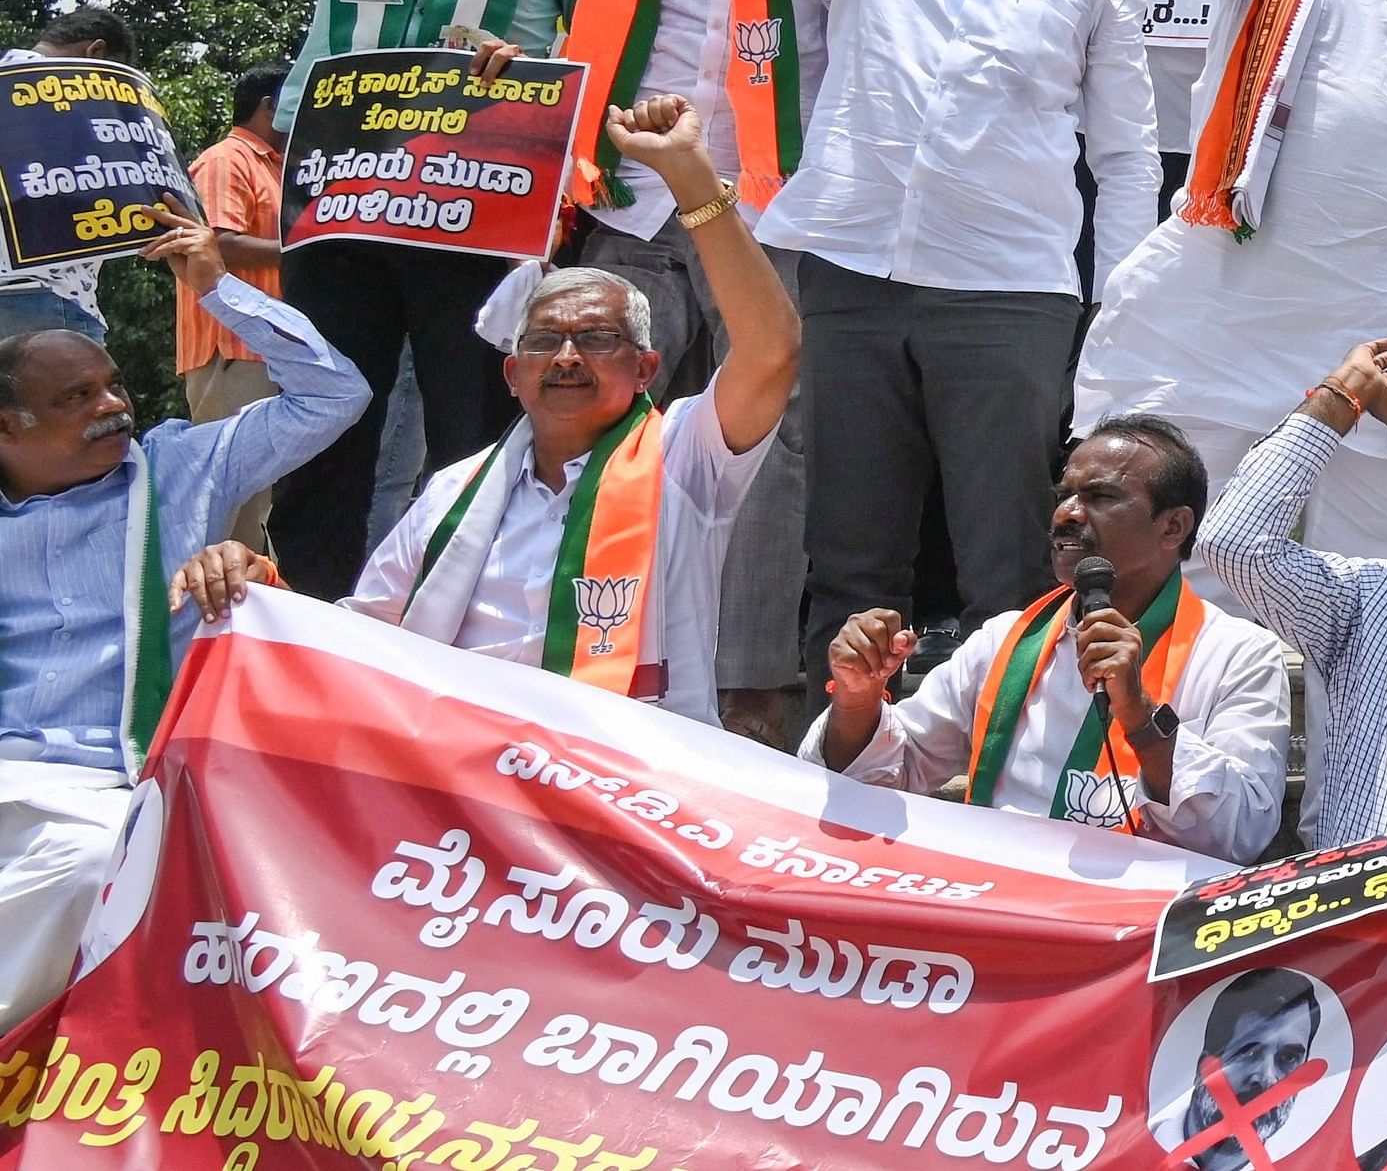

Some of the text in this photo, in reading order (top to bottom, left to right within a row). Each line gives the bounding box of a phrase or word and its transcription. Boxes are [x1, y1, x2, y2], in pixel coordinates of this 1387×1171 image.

[12, 73, 139, 111] ಎಲ್ಲಿವರೆಗೂ
[313, 65, 563, 108] ಭ್ರಷ್ಟ ಕಾಂಗ್ರೆಸ್ ಸರ್ಕಾರ
[361, 102, 468, 134] ತೊಲಗಲಿ
[296, 148, 532, 196] ಮೈಸೂರು ಮುಡಾ
[315, 189, 474, 232] ಉಳಿಯಲಿ
[738, 835, 997, 901] ಕರ್ನಾಟಕ
[371, 828, 976, 1015] ಮೈಸೂರು ಮುಡಾ
[1194, 892, 1352, 954] ಧಿಕ್ಕಾರ...
[183, 912, 531, 1079] ಹಗರಣದಲ್ಲಿ
